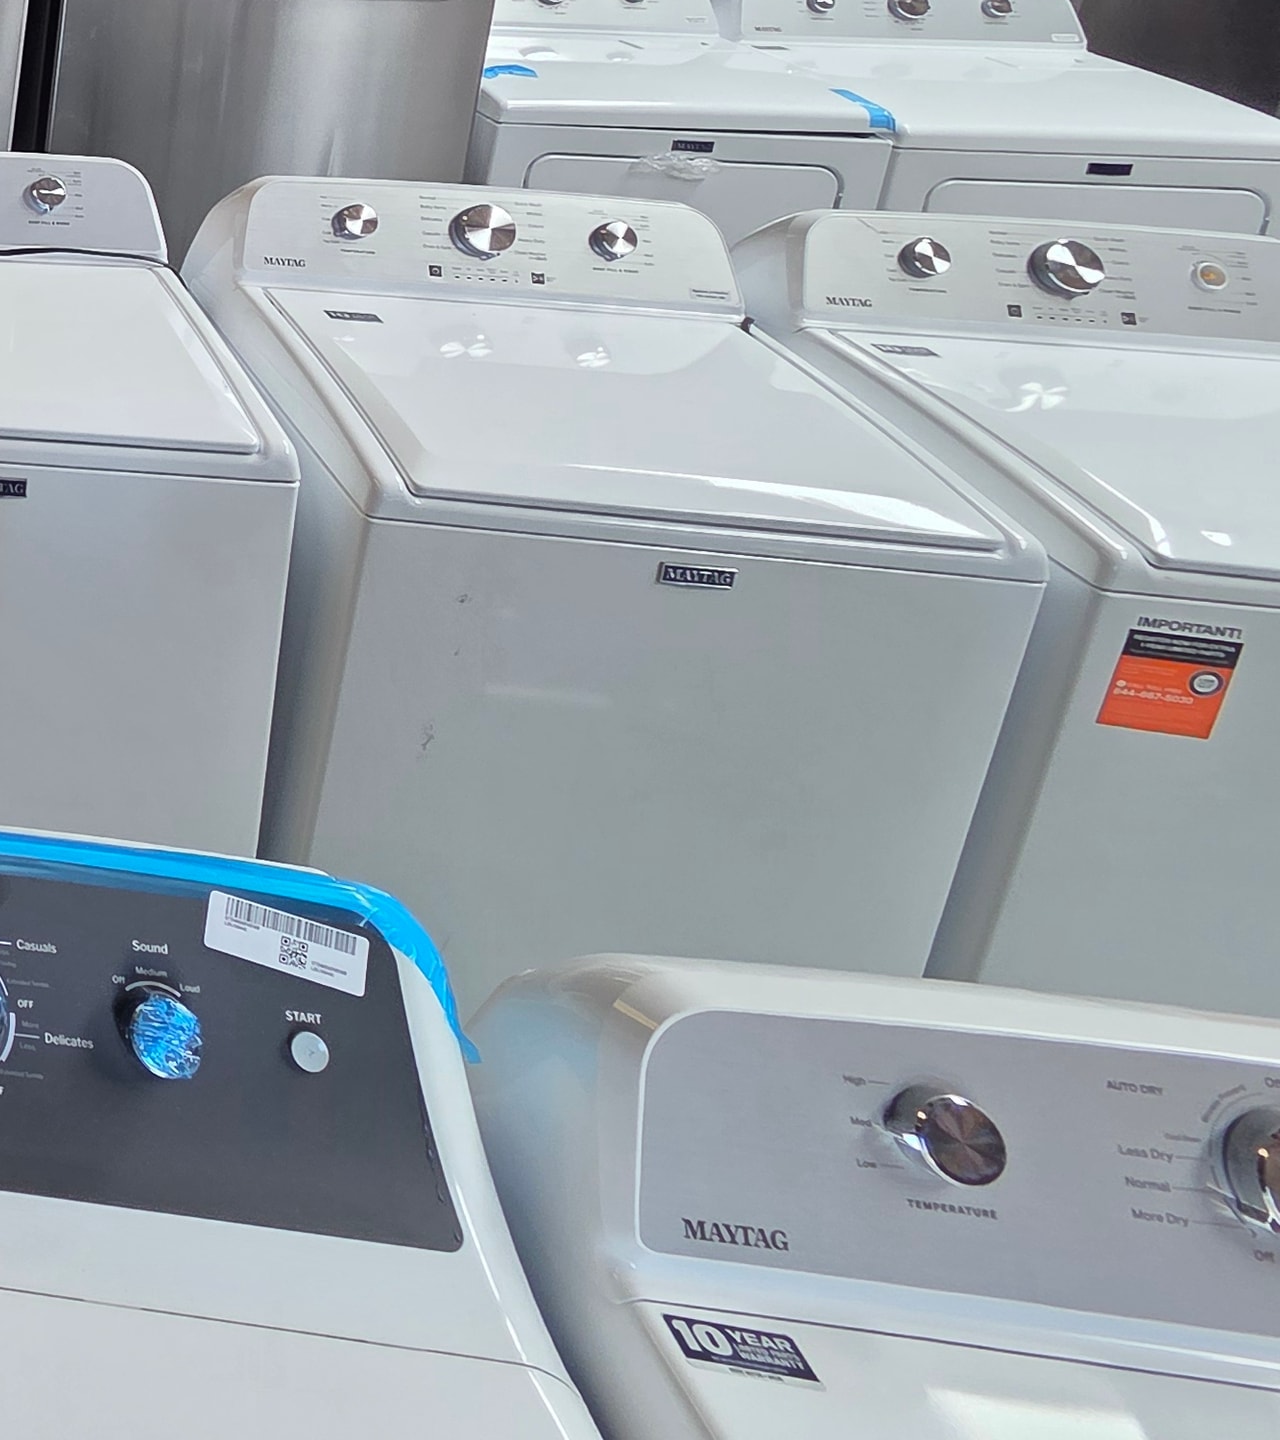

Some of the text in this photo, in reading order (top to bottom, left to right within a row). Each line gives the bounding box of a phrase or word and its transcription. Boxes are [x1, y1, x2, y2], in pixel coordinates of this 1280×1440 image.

[263, 256, 306, 268] MAYTAG
[826, 296, 873, 308] MAYTAG
[666, 568, 731, 584] MAYTAG
[1137, 616, 1243, 640] IMPORTANT!
[16, 939, 57, 954] Casuals
[132, 939, 168, 955] Sound
[112, 974, 125, 984] Off
[135, 966, 168, 978] Medium
[179, 983, 200, 993] Loud
[17, 1000, 34, 1009] OFF
[285, 1010, 322, 1025] START
[44, 1032, 94, 1050] Delicates
[843, 1074, 866, 1087] High
[1106, 1079, 1163, 1095] AUTO DRY
[1118, 1144, 1174, 1163] Less Dry
[856, 1158, 877, 1168] Low
[1125, 1176, 1171, 1192] Normal
[907, 1198, 998, 1220] TEMPERATURE
[1131, 1208, 1189, 1227] More Dry
[681, 1217, 789, 1251] MAYTAG
[1253, 1249, 1276, 1262] Off
[671, 1319, 797, 1357] 10 YEAR
